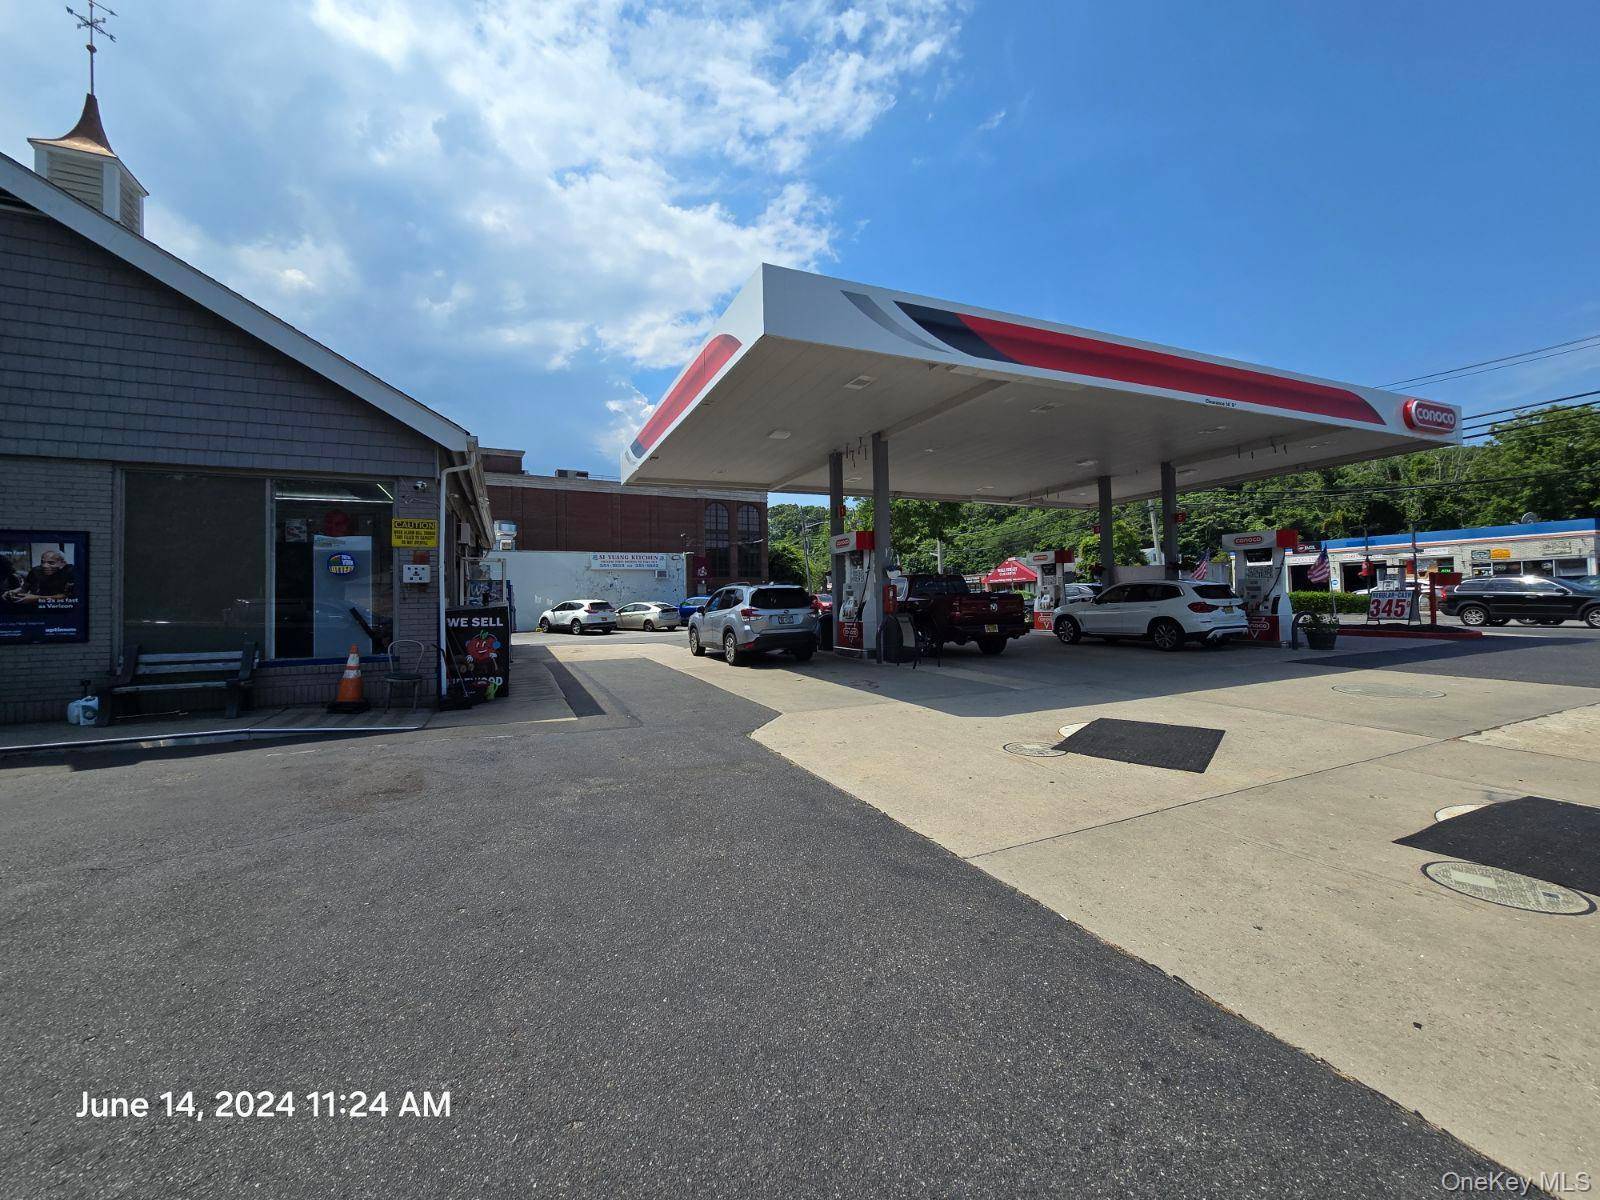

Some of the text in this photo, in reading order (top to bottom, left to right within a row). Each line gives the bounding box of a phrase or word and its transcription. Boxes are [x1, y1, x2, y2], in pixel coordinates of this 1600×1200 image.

[1415, 406, 1454, 425] conoco
[395, 521, 435, 529] CAUTION
[1235, 536, 1261, 544] conoco
[1370, 598, 1406, 618] 345
[447, 617, 504, 627] WE SELL
